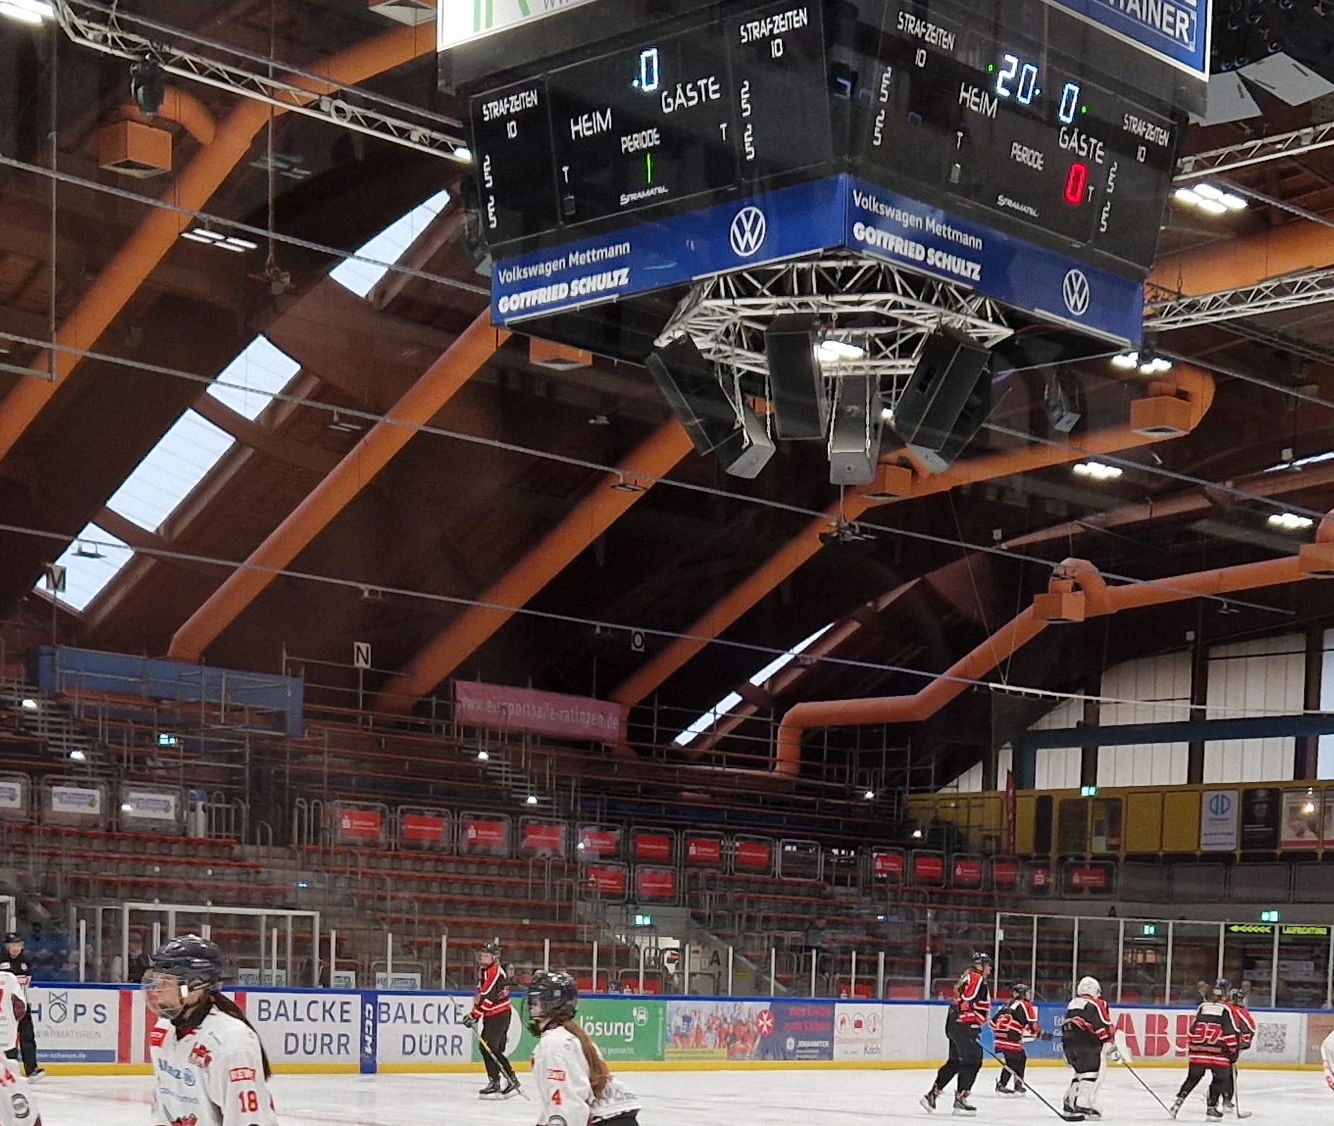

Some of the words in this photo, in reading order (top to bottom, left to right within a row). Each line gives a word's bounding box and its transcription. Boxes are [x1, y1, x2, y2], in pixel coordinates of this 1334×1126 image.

[740, 7, 808, 44] STRAFZEITEN
[897, 11, 955, 52] STRAFZEITEN
[482, 89, 538, 121] STRAFZEITEN
[661, 76, 720, 114] GÄSTE
[959, 82, 998, 120] HEIM
[570, 108, 612, 140] HEIM
[621, 127, 661, 154] PERIODE
[1122, 113, 1169, 147] STRAFZEITEN
[1010, 141, 1044, 172] PERIODE
[1058, 126, 1105, 165] GÄSTE
[1064, 162, 1088, 205] 0
[852, 189, 924, 229] Volkswagen
[925, 218, 983, 251] Mettmann
[497, 257, 567, 285] Volkswagen
[568, 242, 631, 267] Mettmann
[852, 222, 926, 262] GOTTFRIED
[927, 248, 983, 282] SCHULTZ
[498, 280, 569, 314] GOTTFRIED
[569, 267, 631, 298] SCHULTZ
[357, 644, 369, 665] N
[258, 1000, 352, 1022] BALCKE
[379, 1002, 465, 1024] BALCKE
[284, 1032, 351, 1055] DÜRR
[364, 1003, 373, 1055] CCM
[402, 1033, 463, 1056] DÜRR
[239, 1091, 258, 1113] 18
